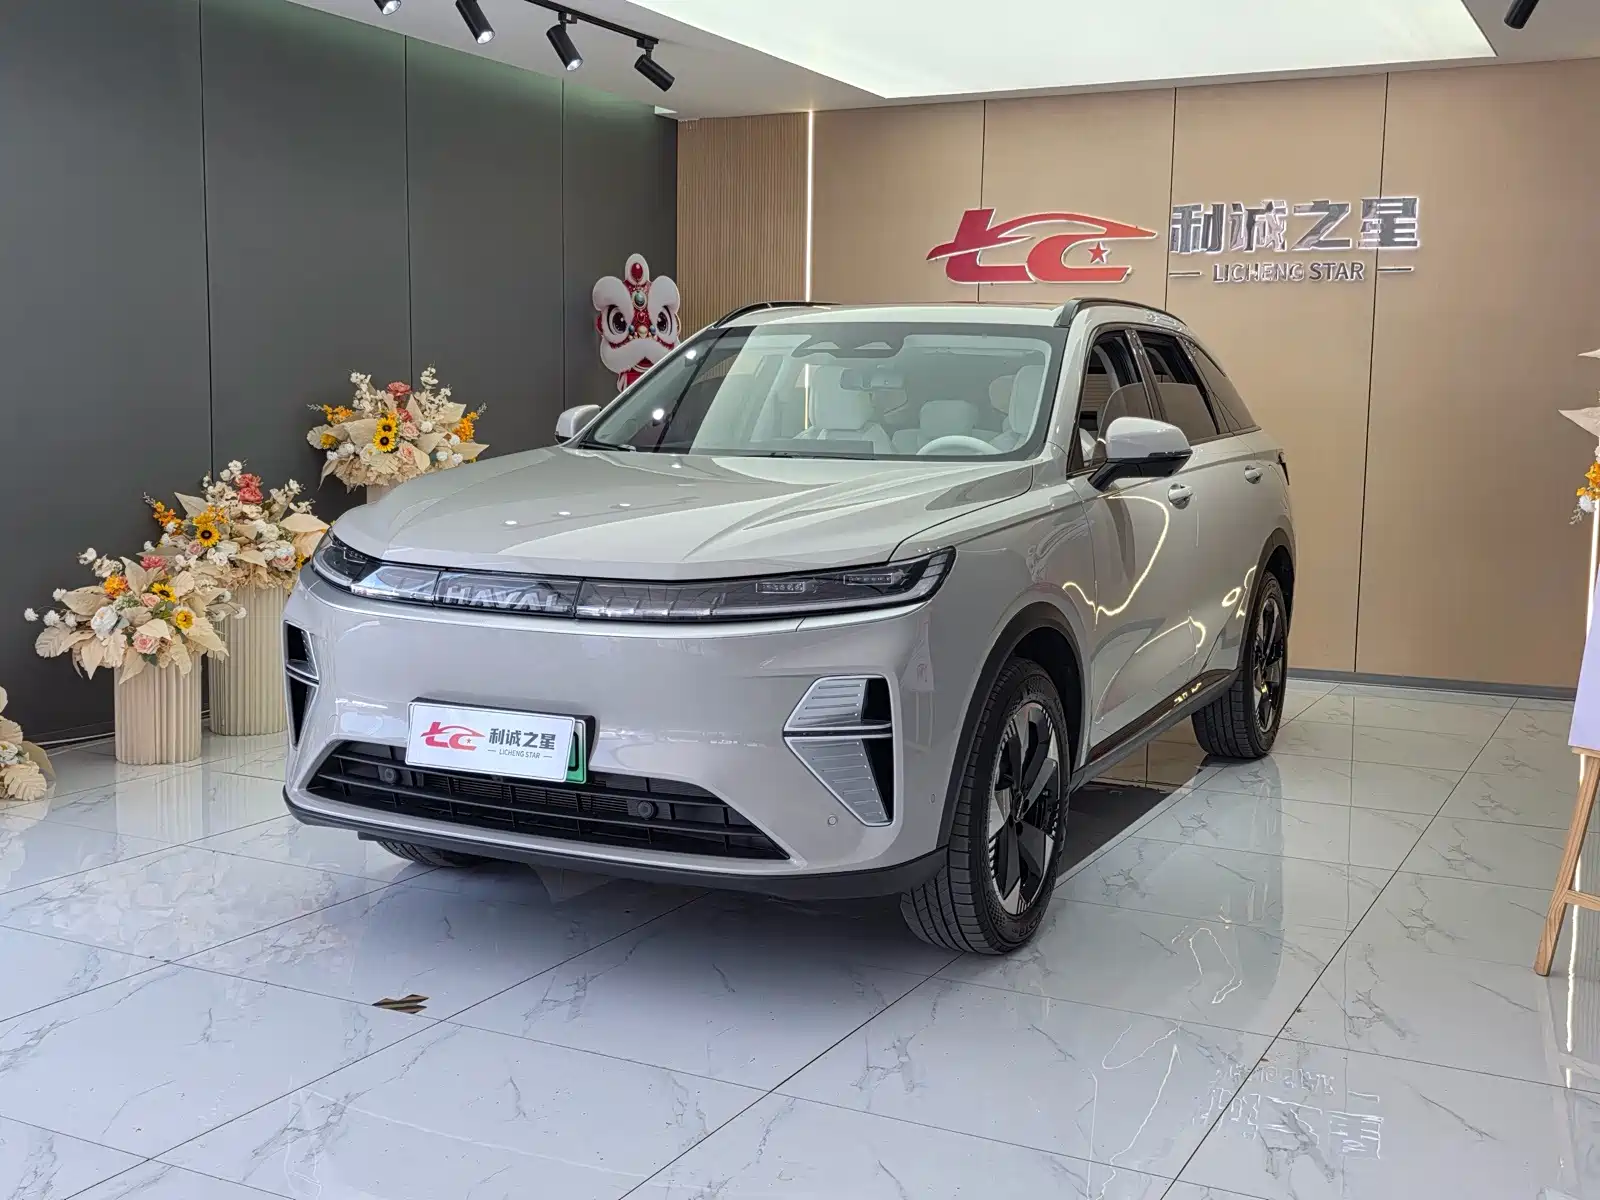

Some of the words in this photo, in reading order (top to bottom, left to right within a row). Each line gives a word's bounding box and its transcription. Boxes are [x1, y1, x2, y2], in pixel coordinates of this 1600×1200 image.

[1169, 195, 1420, 254] 利诚之星
[1212, 263, 1304, 283] LICHENG
[1309, 261, 1365, 281] STAR
[443, 585, 566, 613] HAVAL
[488, 728, 556, 750] 利诚之星
[499, 748, 525, 758] LICHENG
[525, 751, 541, 759] STAR
